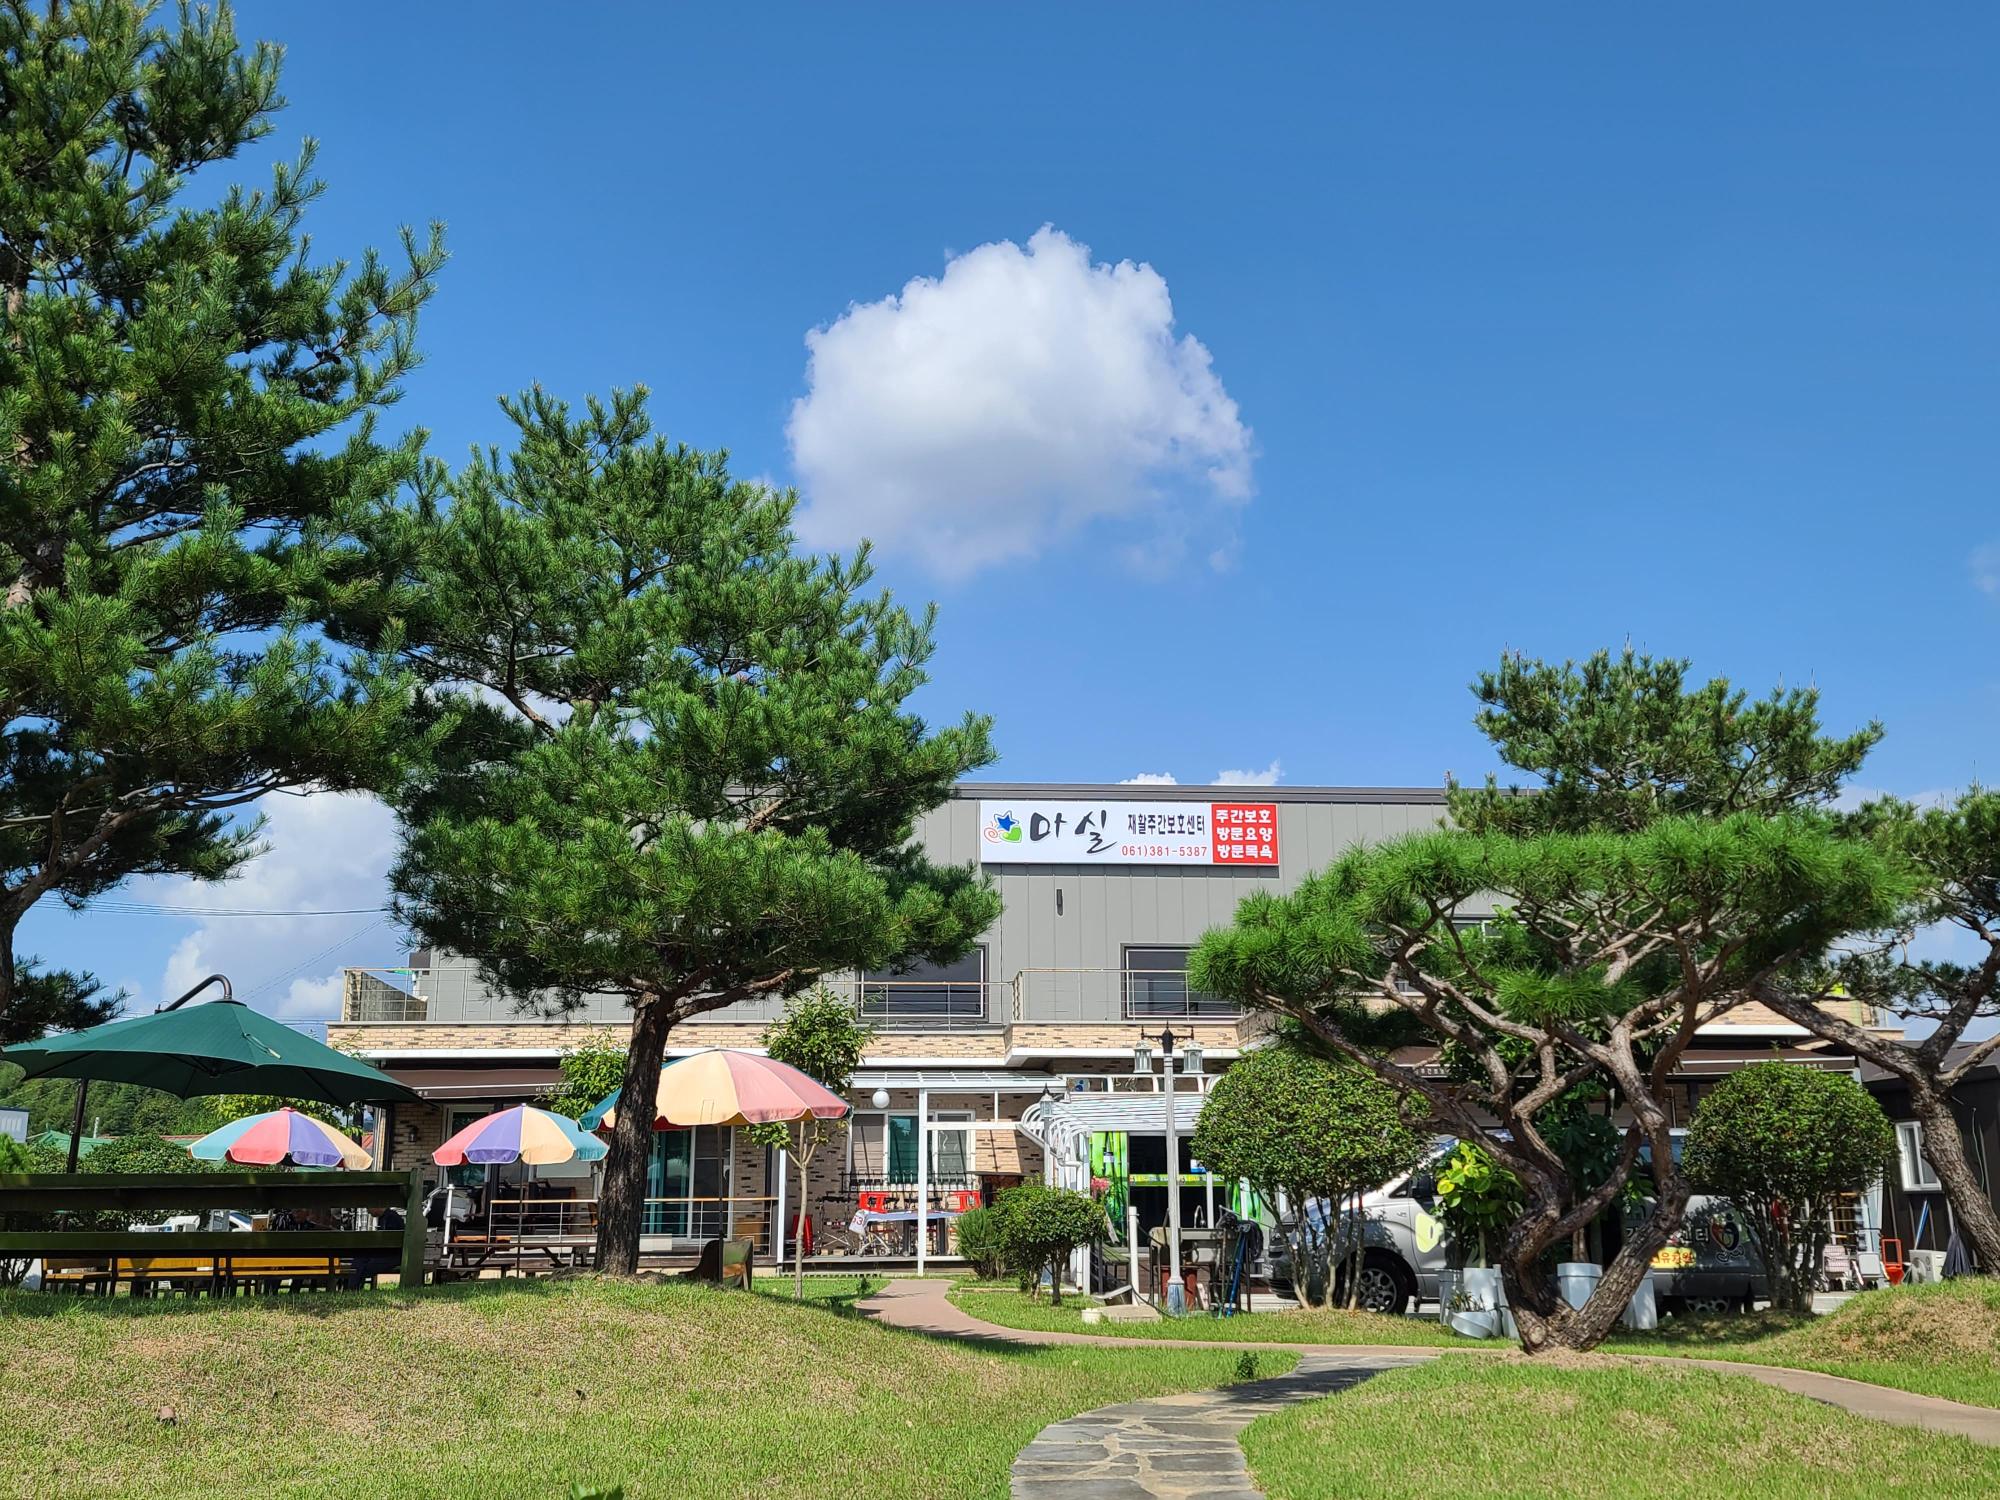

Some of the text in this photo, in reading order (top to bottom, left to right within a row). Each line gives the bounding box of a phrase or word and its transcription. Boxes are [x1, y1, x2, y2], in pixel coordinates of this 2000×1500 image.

[1127, 813, 1206, 835] 재활주간보호센터
[1216, 809, 1272, 824] 주간보호
[1029, 809, 1118, 854] 마실
[1216, 827, 1273, 842] 방문요양
[1121, 845, 1208, 857] 061)381-5387
[1217, 844, 1273, 859] 방문목욕
